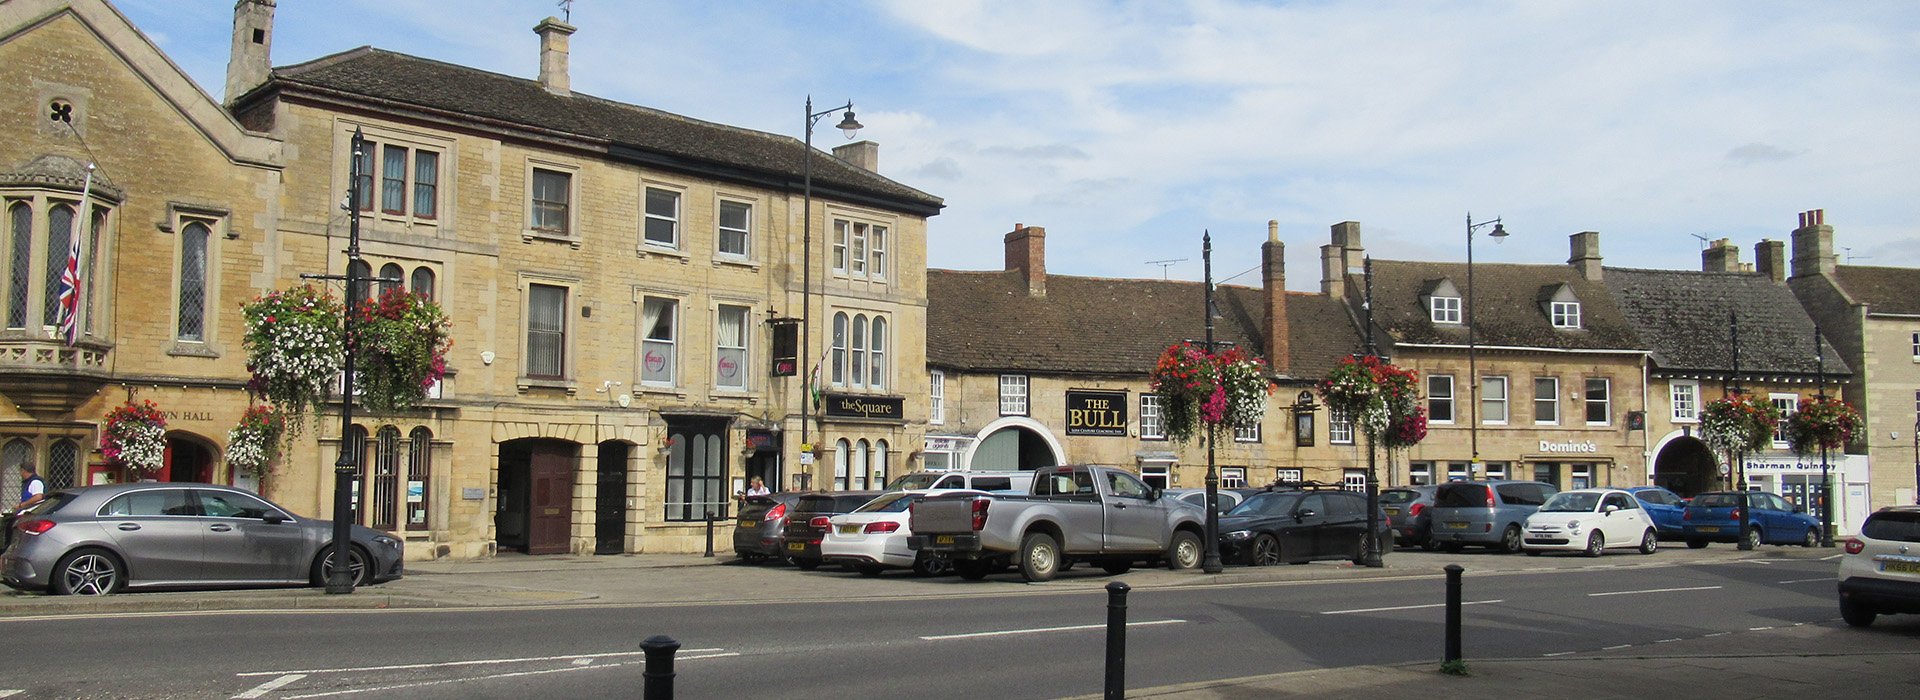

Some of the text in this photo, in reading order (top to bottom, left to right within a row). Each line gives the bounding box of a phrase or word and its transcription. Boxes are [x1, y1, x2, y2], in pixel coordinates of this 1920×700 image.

[1085, 399, 1110, 409] THE
[183, 411, 214, 421] HALL
[1069, 408, 1125, 428] BULL
[1539, 440, 1597, 452] Domino's
[1746, 462, 1791, 470] Sharman
